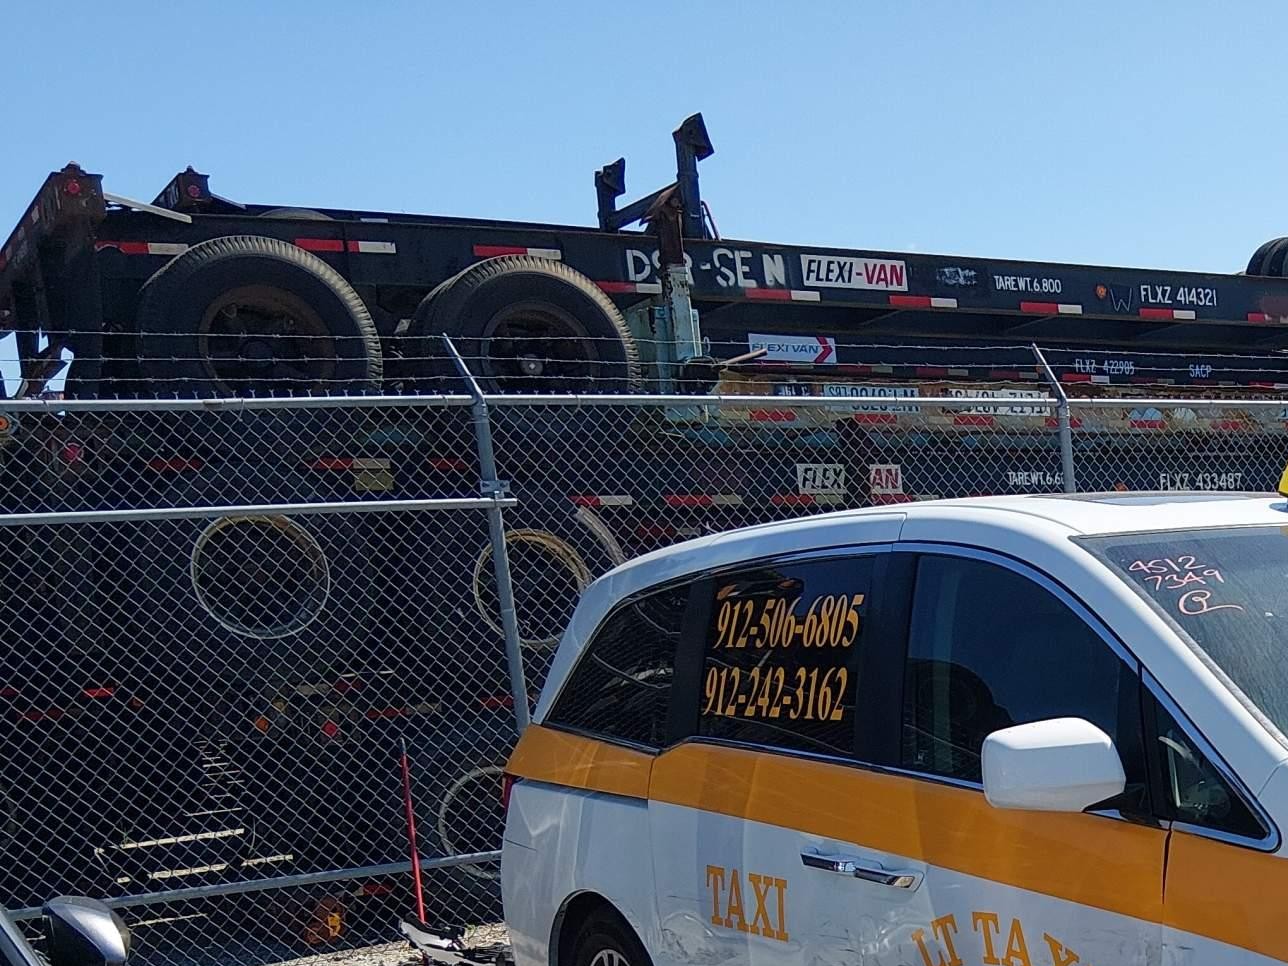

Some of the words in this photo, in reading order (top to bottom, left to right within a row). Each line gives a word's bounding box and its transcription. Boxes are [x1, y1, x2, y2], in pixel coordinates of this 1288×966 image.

[806, 259, 904, 288] FLEXI-VAN
[1140, 285, 1172, 304] FLXZ
[1177, 286, 1217, 306] 414321
[1075, 358, 1097, 373] FLXZ
[1159, 473, 1190, 491] FLXZ
[713, 593, 865, 649] 912-506-6805
[702, 666, 848, 721] 912-242-3162
[706, 864, 789, 942] TAXI
